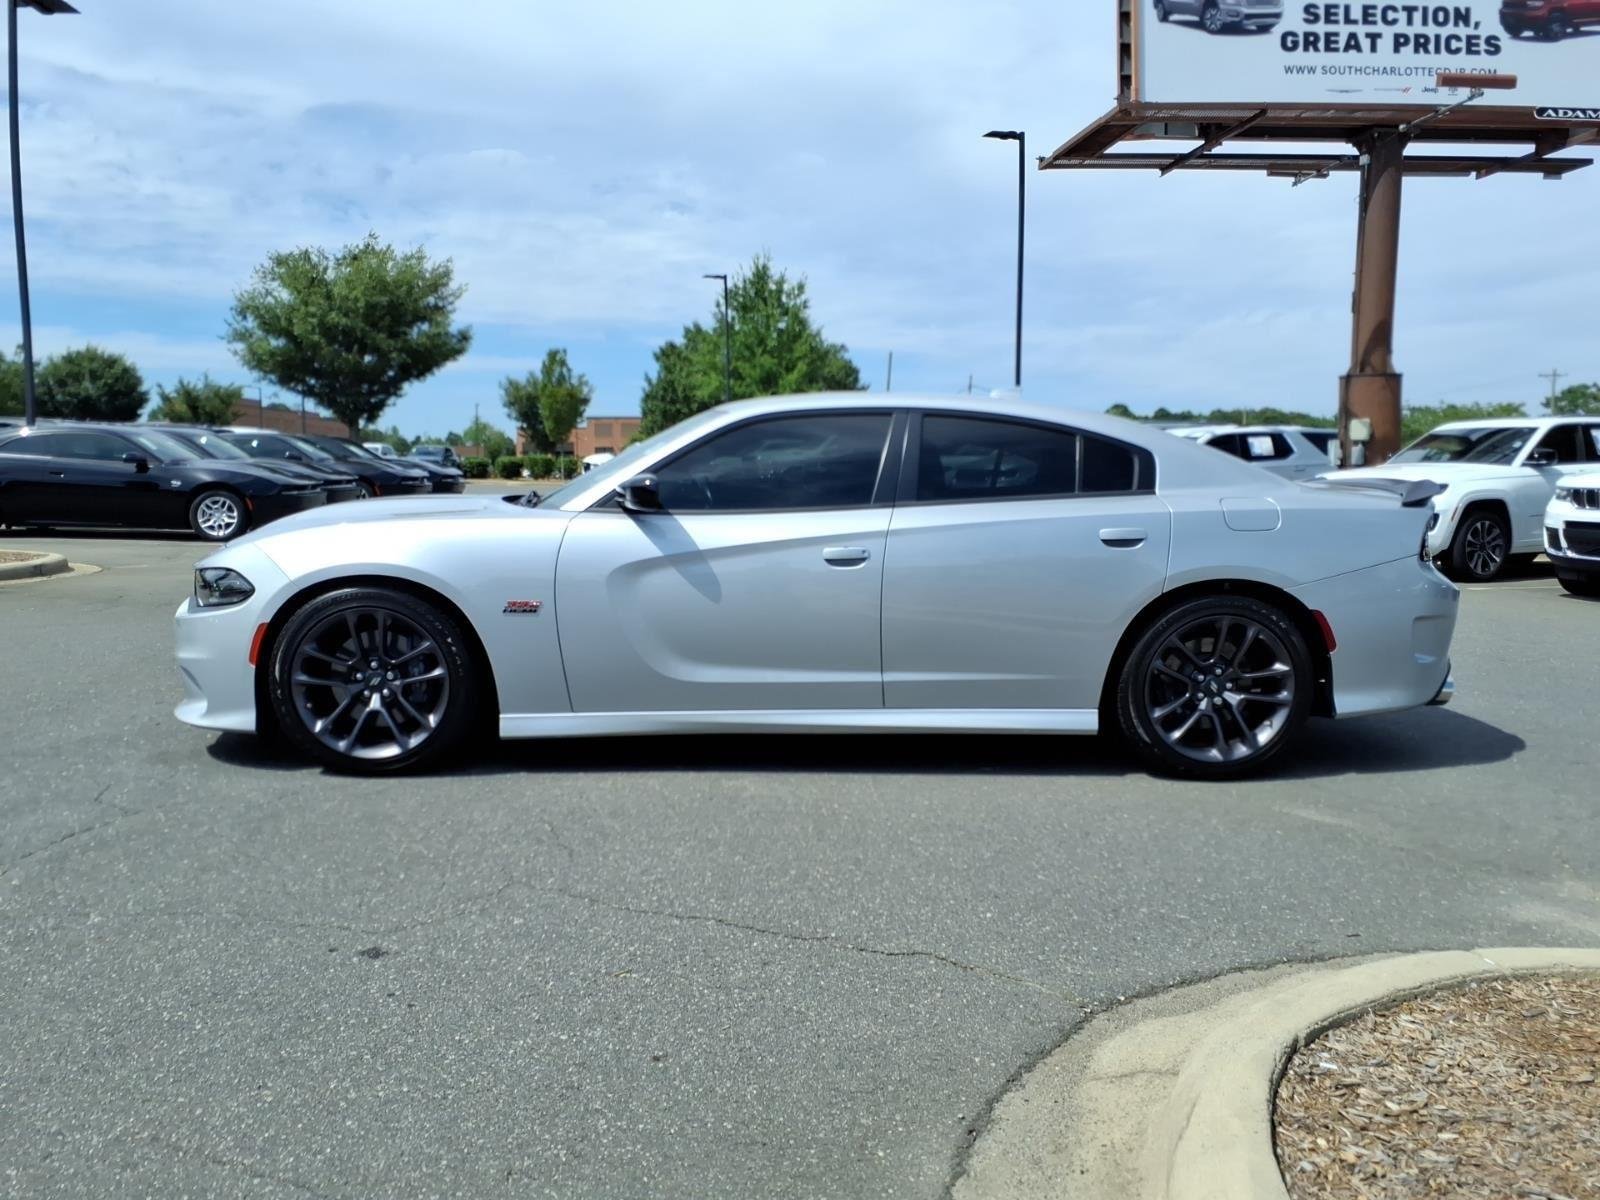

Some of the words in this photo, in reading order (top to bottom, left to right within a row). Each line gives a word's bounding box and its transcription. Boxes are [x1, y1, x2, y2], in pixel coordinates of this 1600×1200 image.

[1303, 3, 1481, 30] SELECTION,
[1280, 30, 1383, 53] GREAT
[1393, 32, 1502, 56] PRICES
